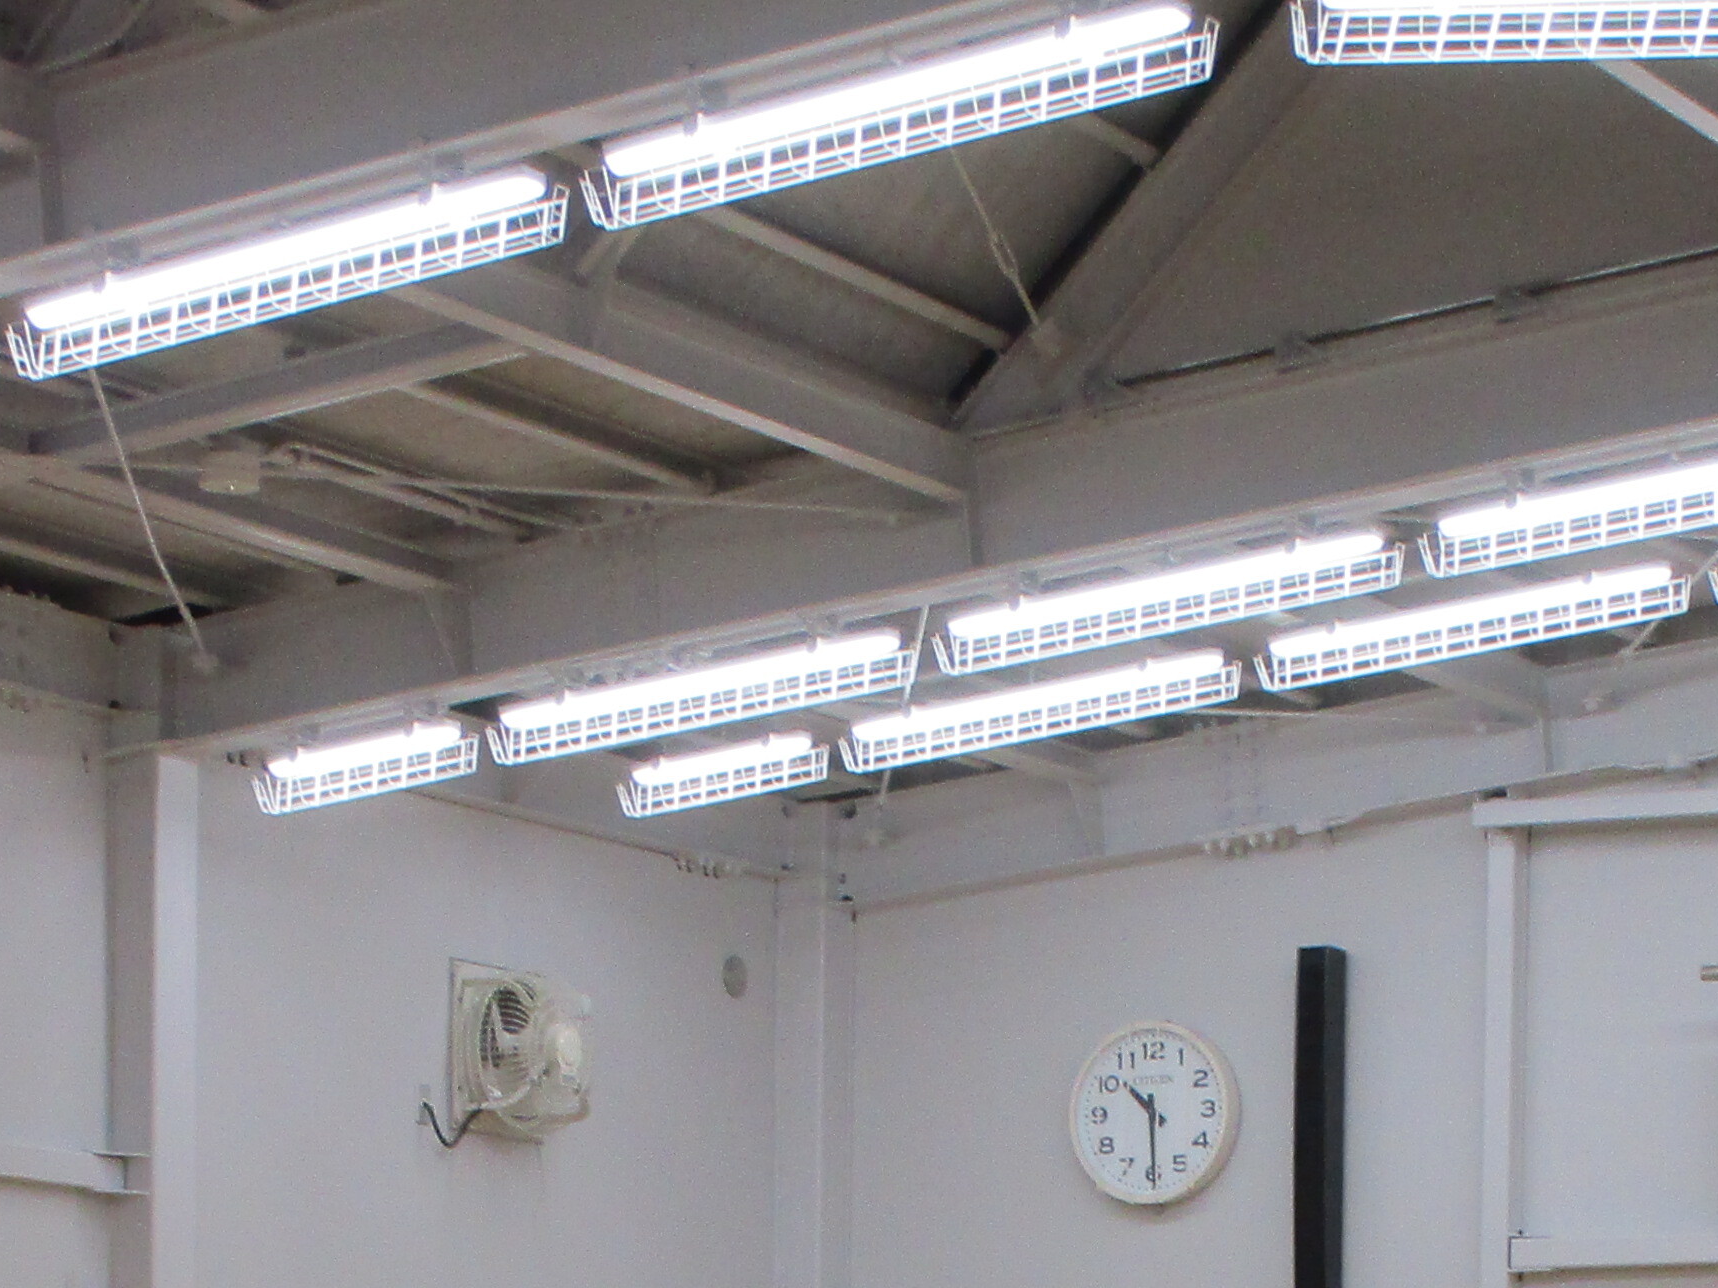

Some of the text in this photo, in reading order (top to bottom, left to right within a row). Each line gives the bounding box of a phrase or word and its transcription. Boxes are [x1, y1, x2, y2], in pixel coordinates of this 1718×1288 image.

[1142, 1041, 1165, 1060] 12
[1178, 1048, 1184, 1066] 1
[1117, 1051, 1136, 1070] 11
[1098, 1074, 1120, 1093] 10
[1193, 1069, 1209, 1088] 2
[1091, 1106, 1108, 1125] 9
[1201, 1099, 1216, 1118] 3
[1099, 1137, 1115, 1154] 8
[1192, 1131, 1209, 1149] 4
[1119, 1157, 1135, 1177] 7
[1173, 1154, 1187, 1172] 5
